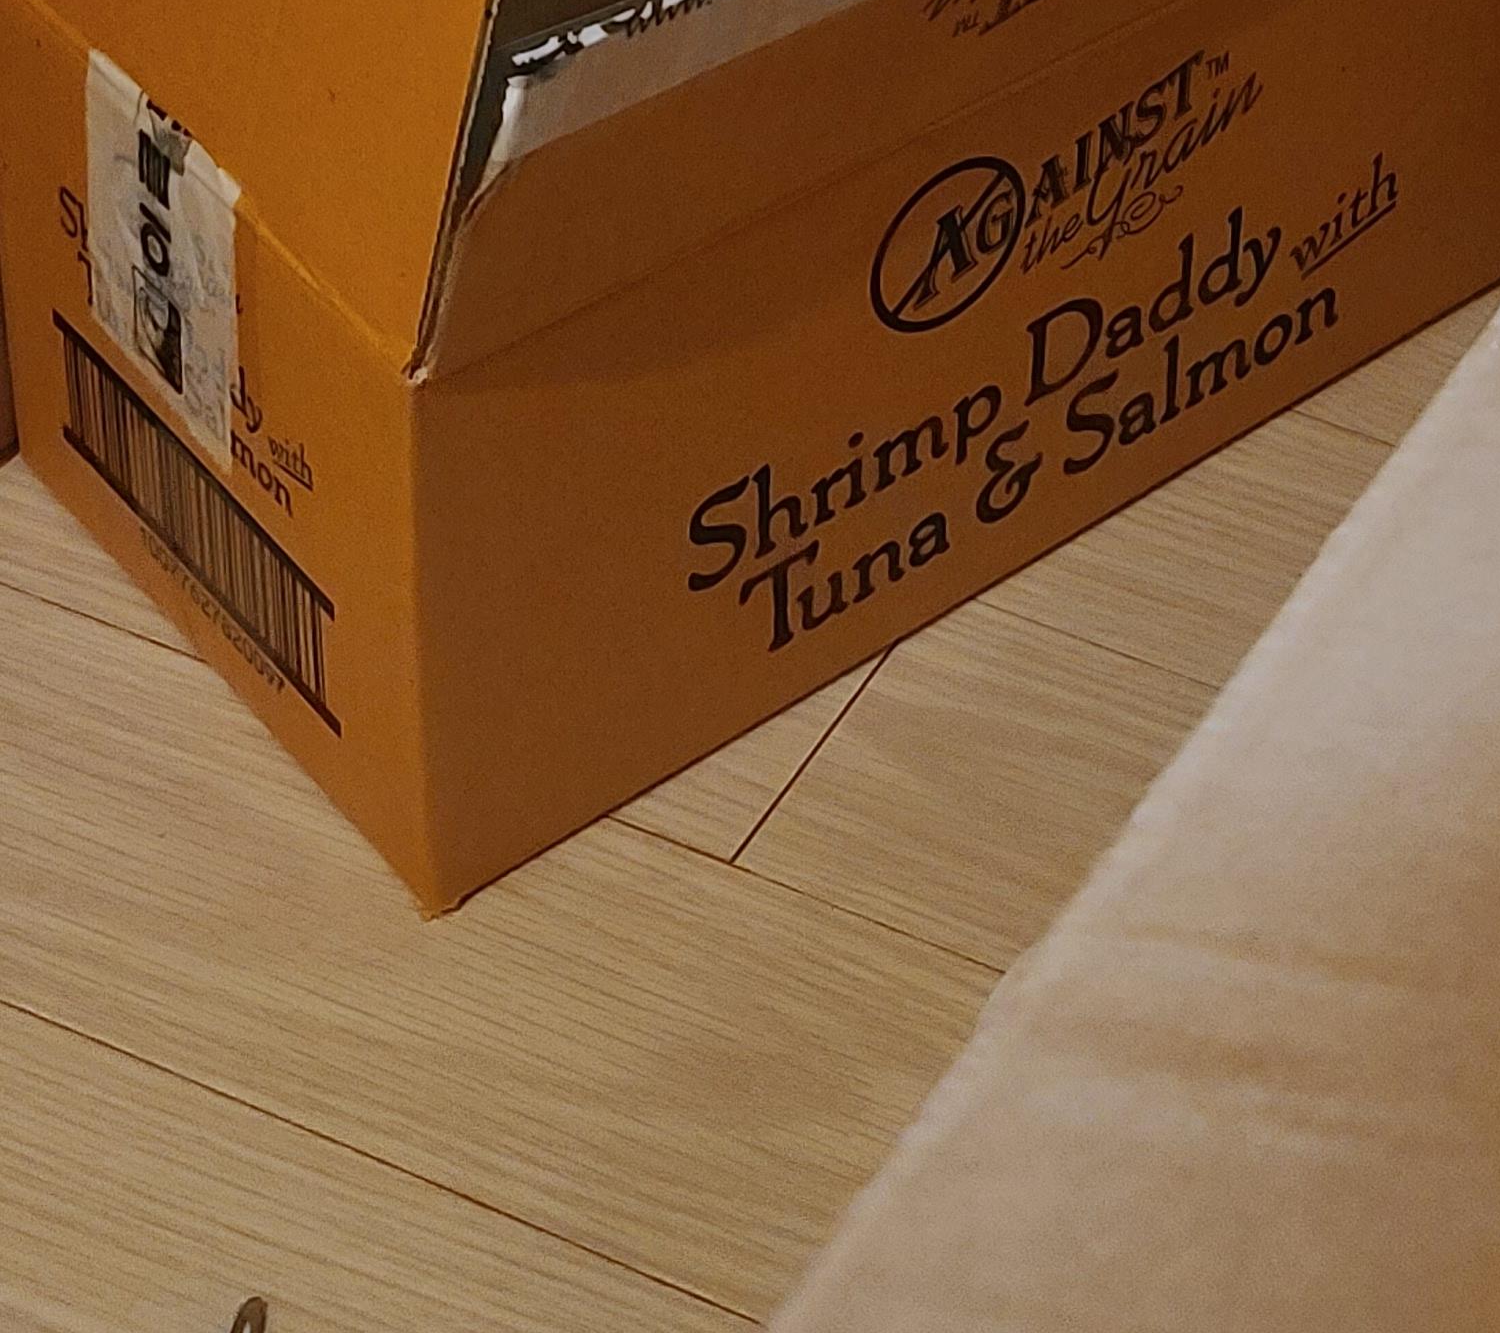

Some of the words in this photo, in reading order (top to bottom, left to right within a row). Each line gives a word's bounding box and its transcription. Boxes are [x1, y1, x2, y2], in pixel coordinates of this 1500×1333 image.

[906, 49, 1204, 312] AGAINST
[1020, 209, 1080, 276] the
[1076, 71, 1264, 257] Grain
[268, 435, 314, 492] with
[688, 381, 1001, 592] Shrimp
[1024, 206, 1282, 407] Daddy
[1291, 152, 1400, 275] with
[740, 511, 950, 653] Tuna
[975, 420, 1040, 524] &
[1062, 286, 1340, 476] Salmon
